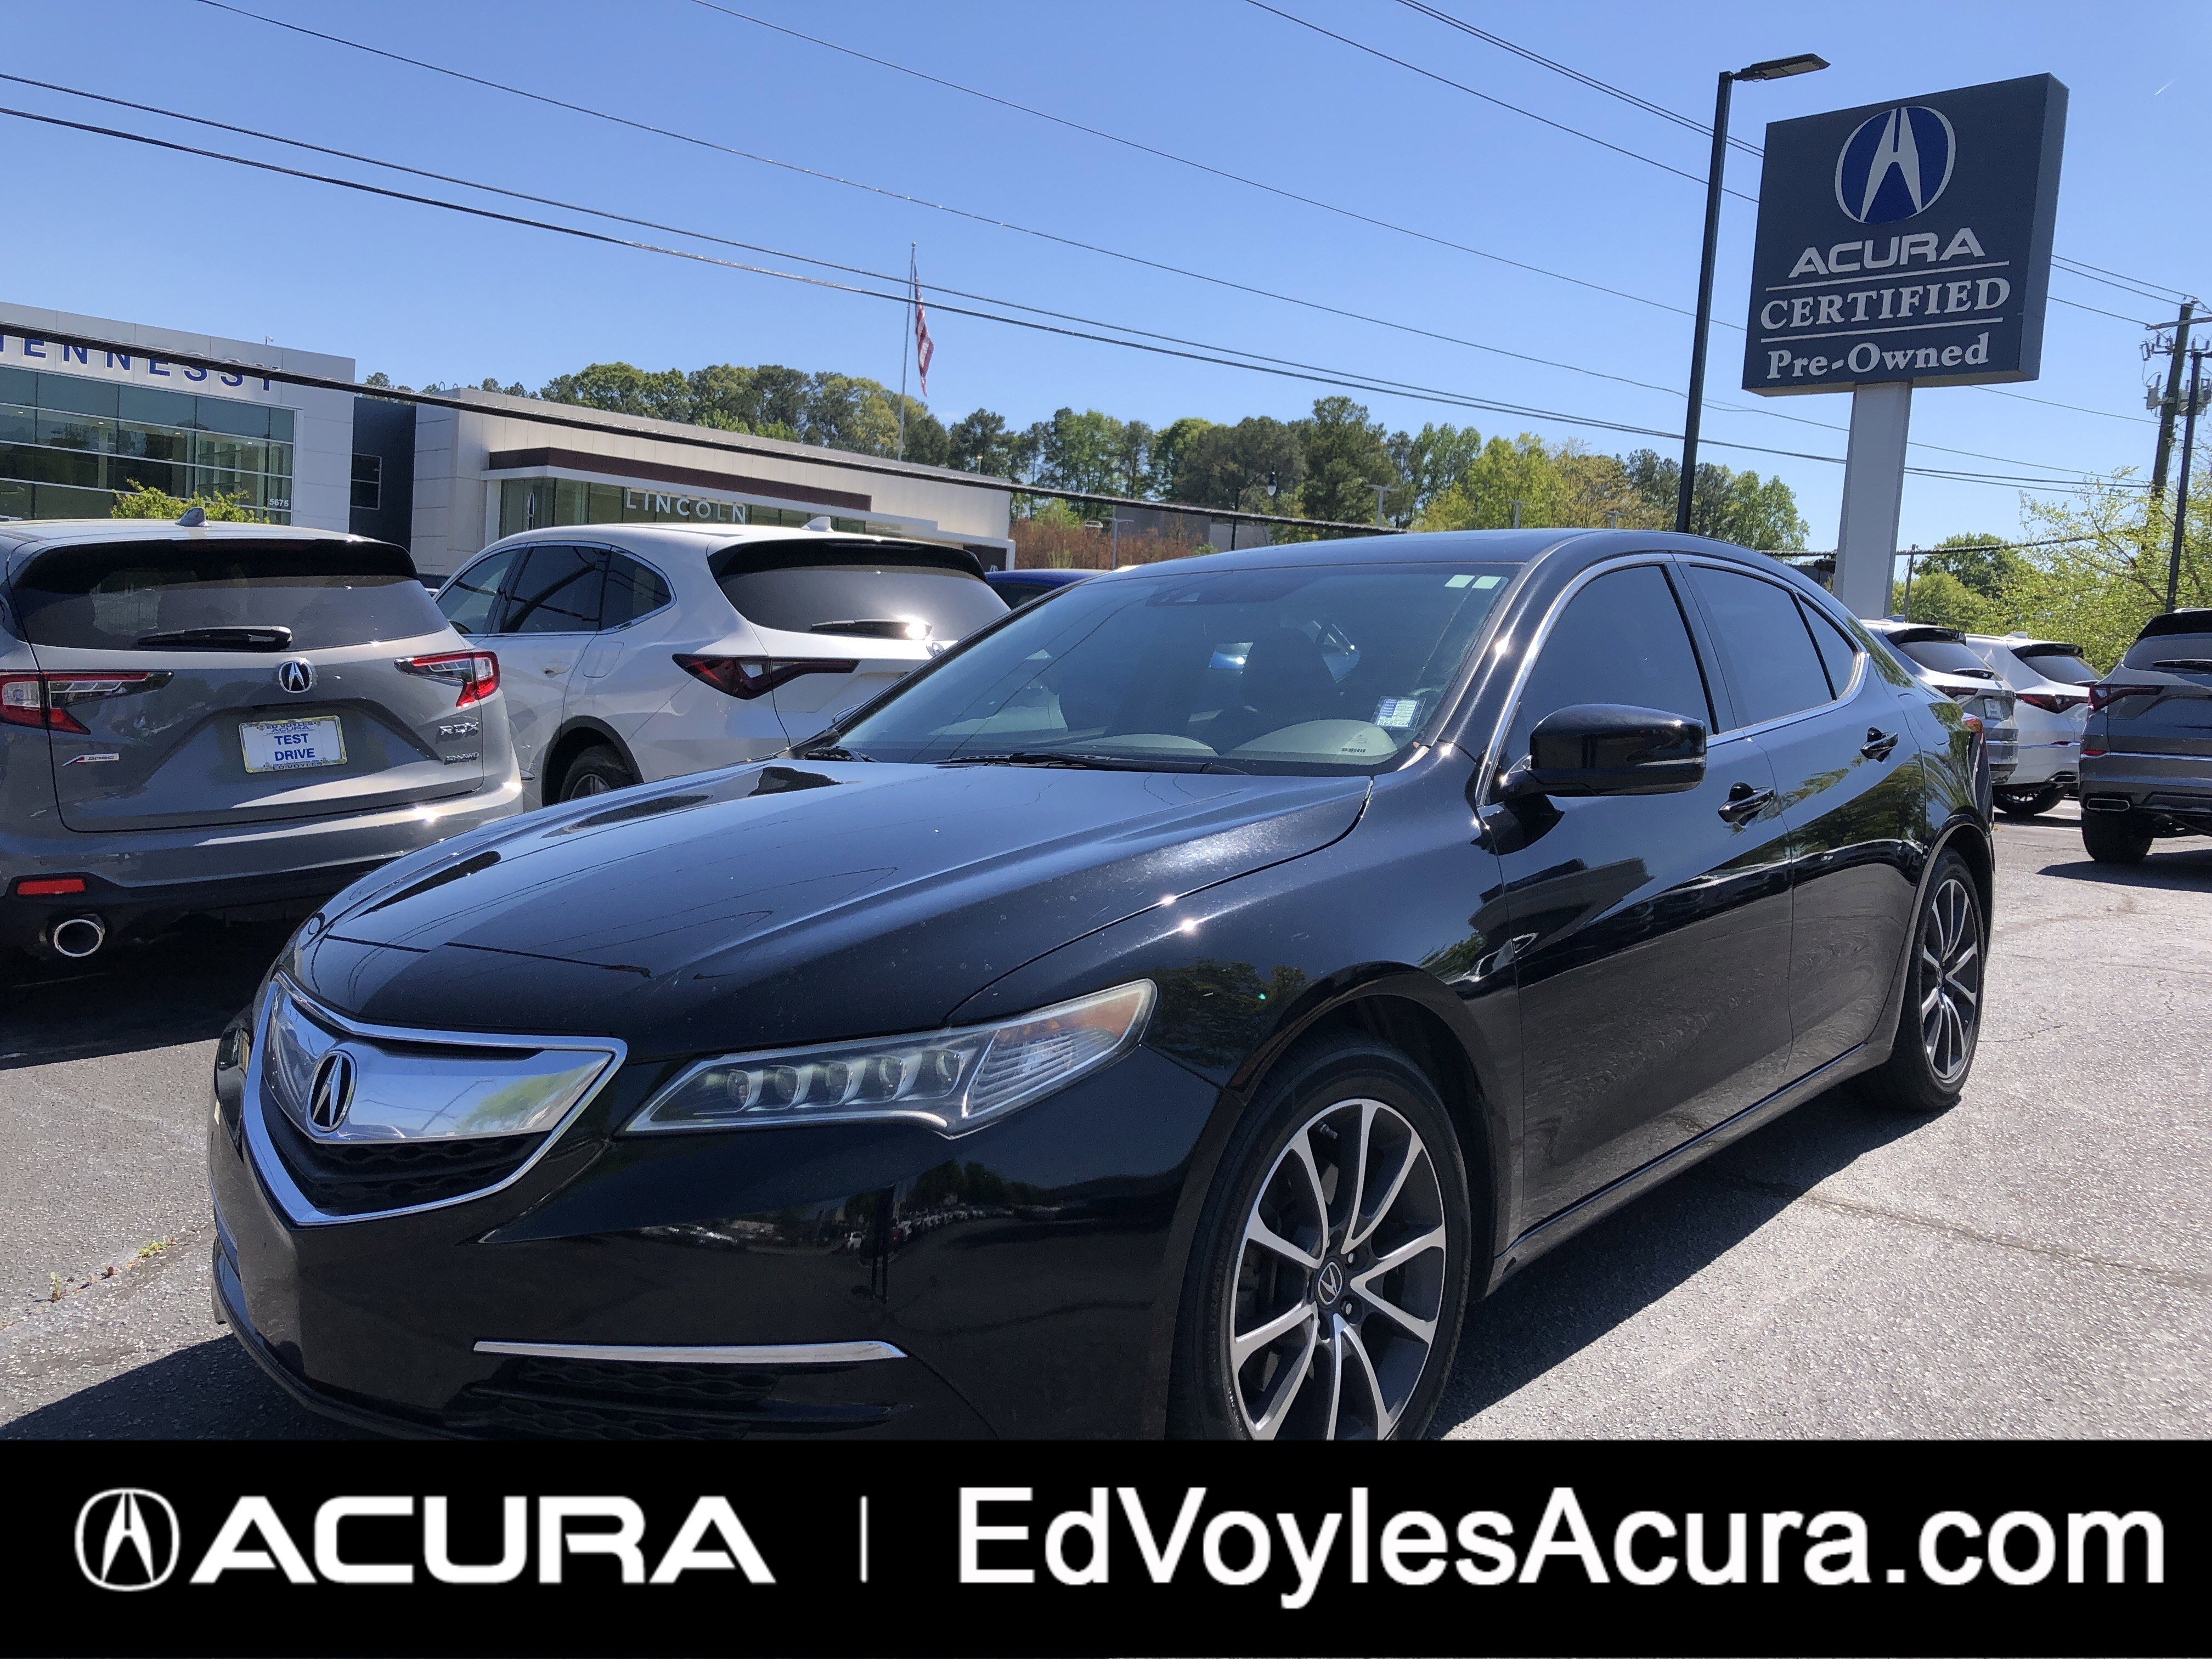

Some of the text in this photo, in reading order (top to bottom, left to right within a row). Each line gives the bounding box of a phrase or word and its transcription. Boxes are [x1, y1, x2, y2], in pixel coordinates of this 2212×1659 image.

[1788, 227, 1985, 278] ACURA
[1760, 277, 2010, 330] CERTIFIED
[0, 334, 280, 391] ENNESSY
[1767, 332, 1990, 379] Pre-Owned
[269, 498, 289, 507] 5675
[627, 489, 746, 524] LINCOLN
[274, 733, 308, 745] TEST
[274, 748, 315, 761] DRIVE
